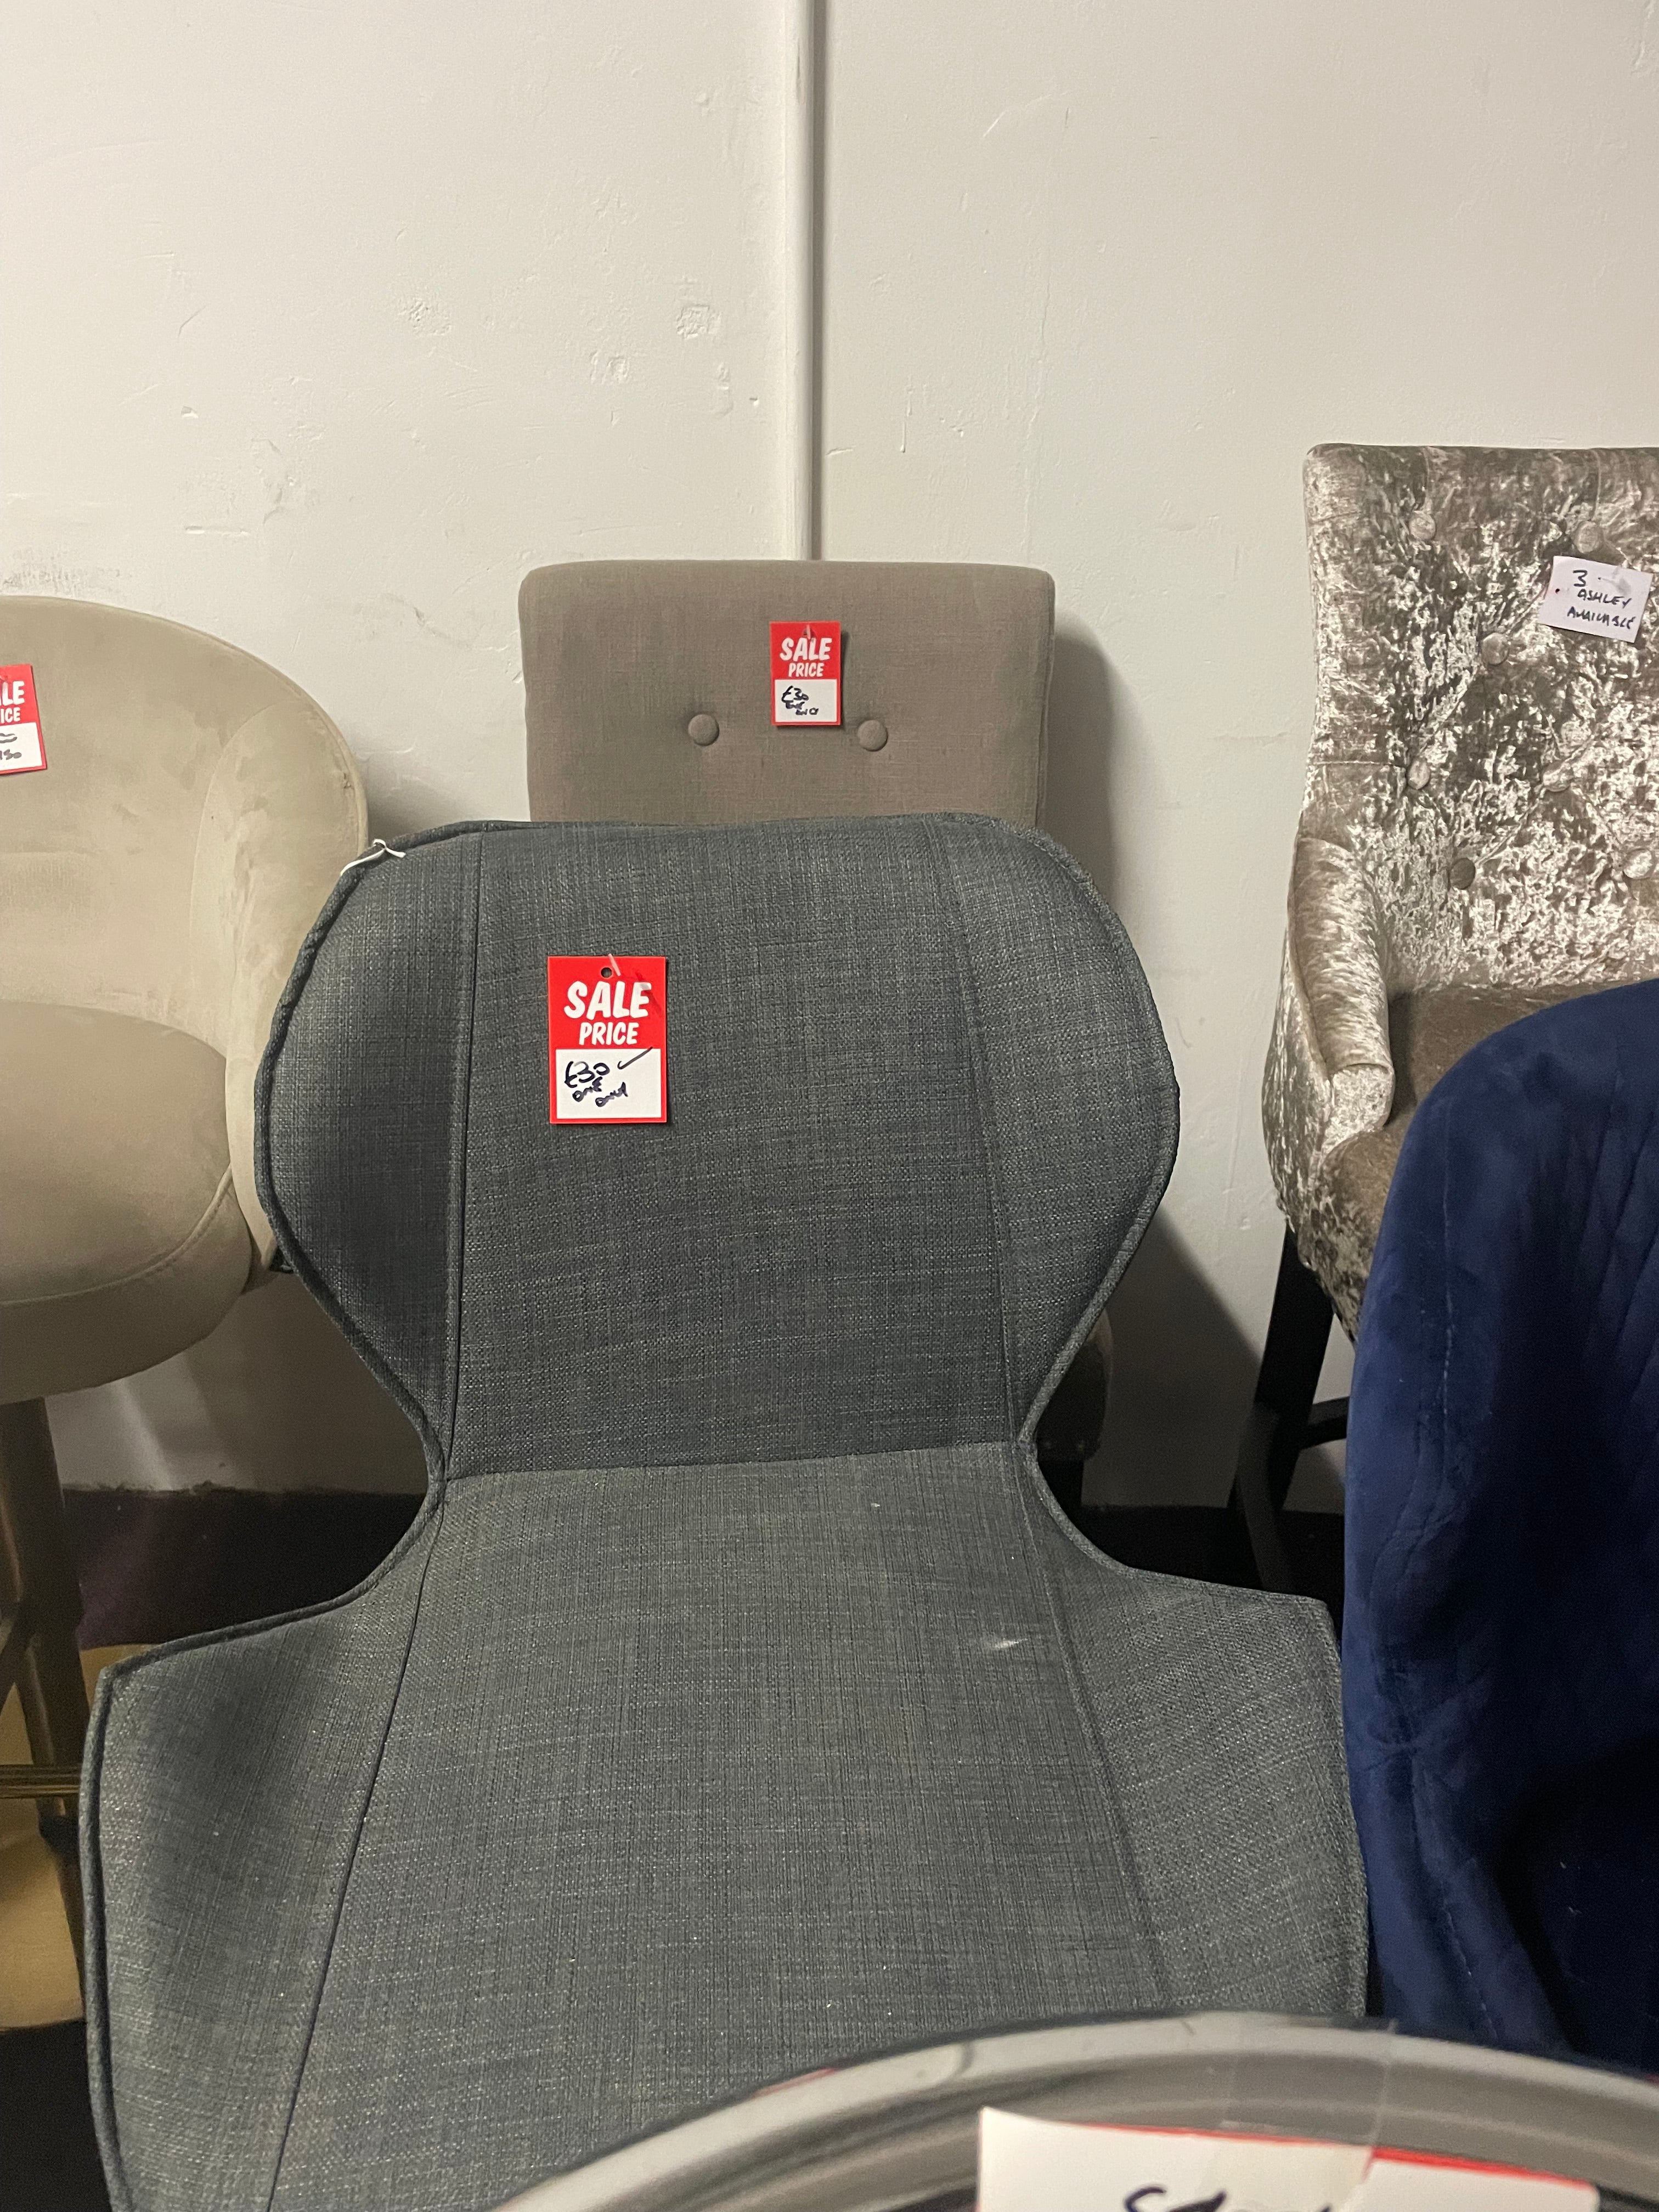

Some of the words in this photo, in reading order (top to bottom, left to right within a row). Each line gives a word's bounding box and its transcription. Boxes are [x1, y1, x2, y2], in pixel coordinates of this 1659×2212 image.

[1572, 569, 1588, 586] 3
[780, 637, 833, 662] SALE
[788, 662, 825, 678] PRICE
[0, 681, 25, 707] LE
[0, 707, 21, 724] ICE
[564, 981, 652, 1020] SALE
[579, 1022, 639, 1045] PRICE
[565, 1060, 610, 1088] £30
